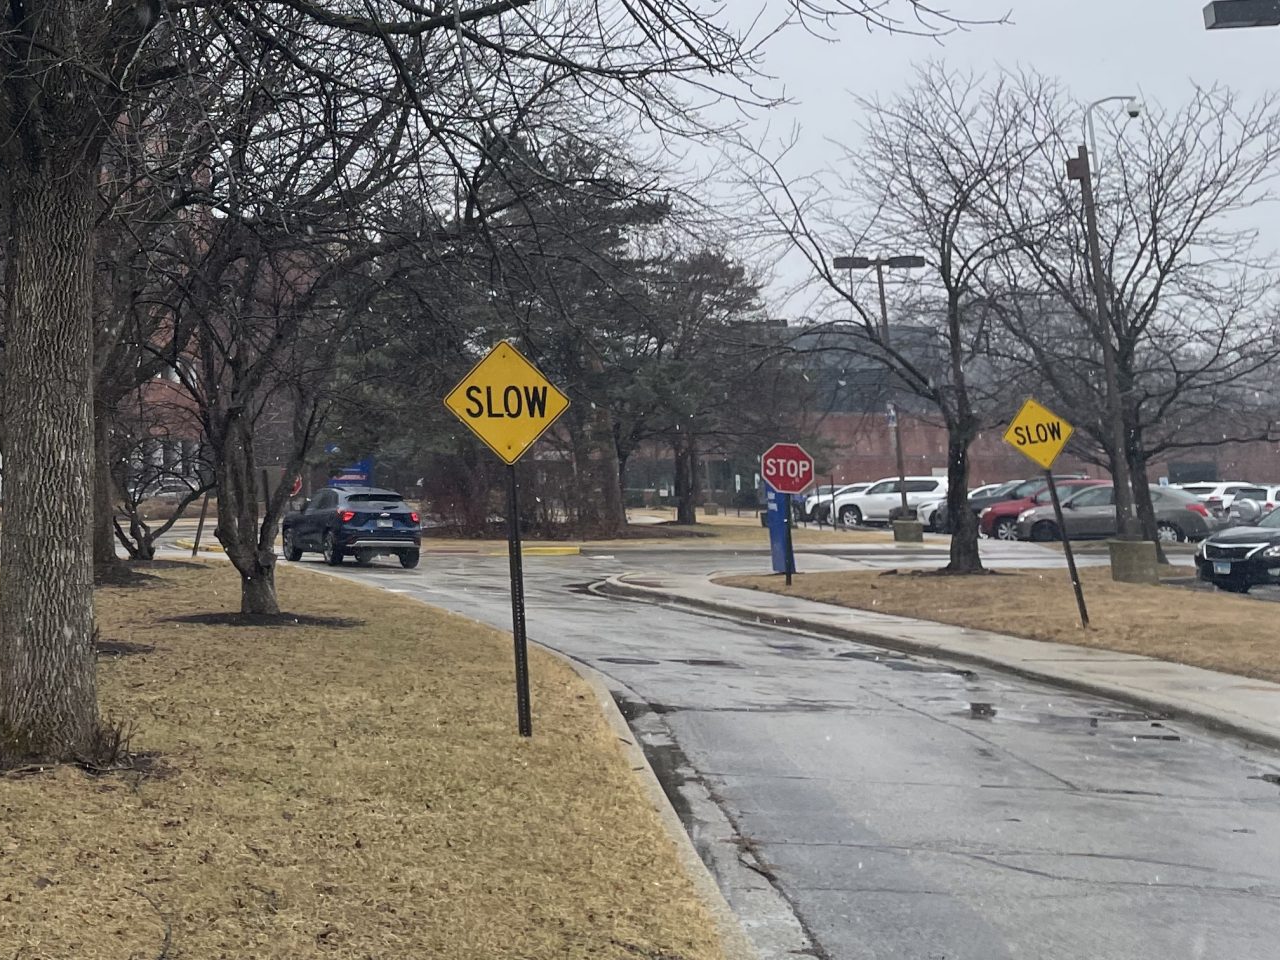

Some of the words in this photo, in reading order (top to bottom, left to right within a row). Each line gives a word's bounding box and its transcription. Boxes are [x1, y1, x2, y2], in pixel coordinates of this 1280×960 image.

[465, 385, 547, 418] SLOW
[1014, 421, 1061, 445] SLOW
[766, 458, 810, 478] STOP
